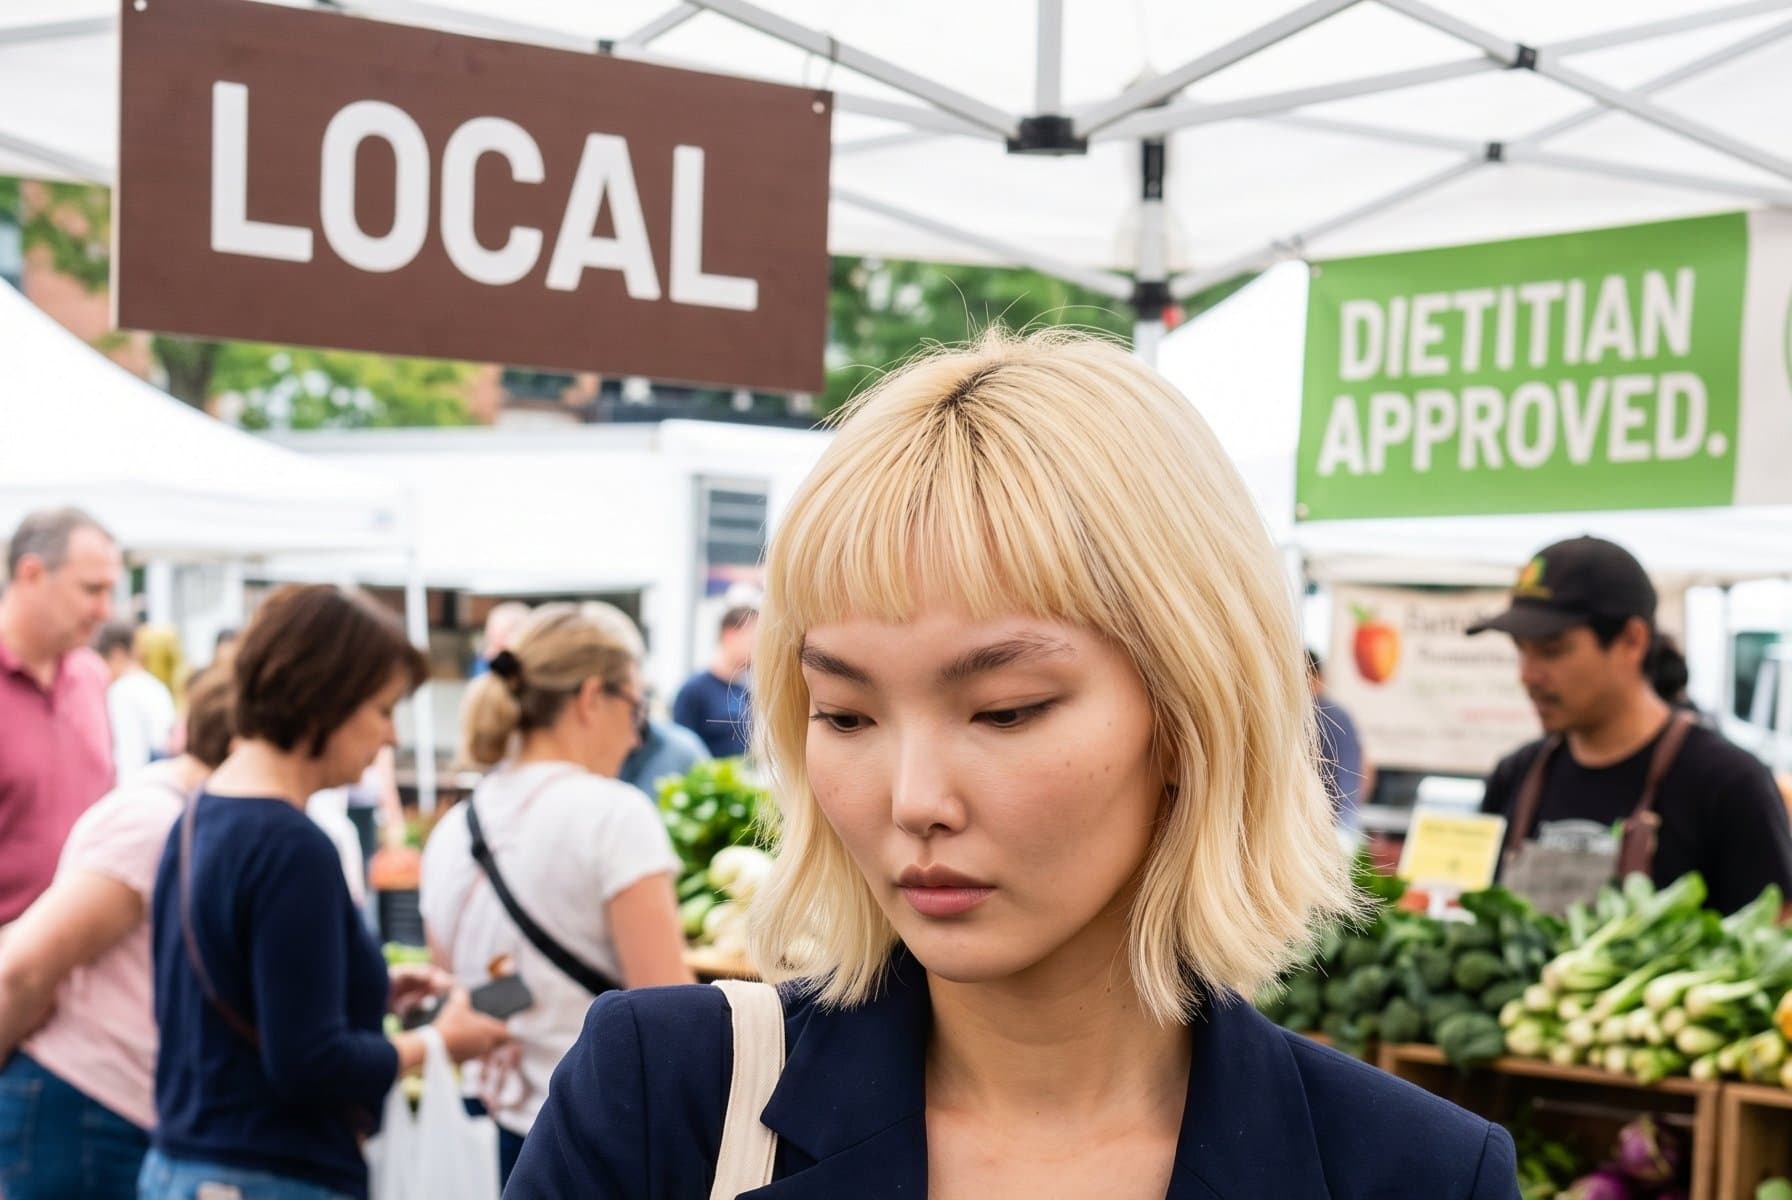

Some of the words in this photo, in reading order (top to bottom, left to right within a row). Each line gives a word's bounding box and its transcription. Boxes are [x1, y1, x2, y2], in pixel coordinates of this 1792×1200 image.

[211, 80, 758, 311] LOCAL
[1338, 267, 1696, 382] DIETITIAN
[1316, 371, 1728, 477] APPROVED.
